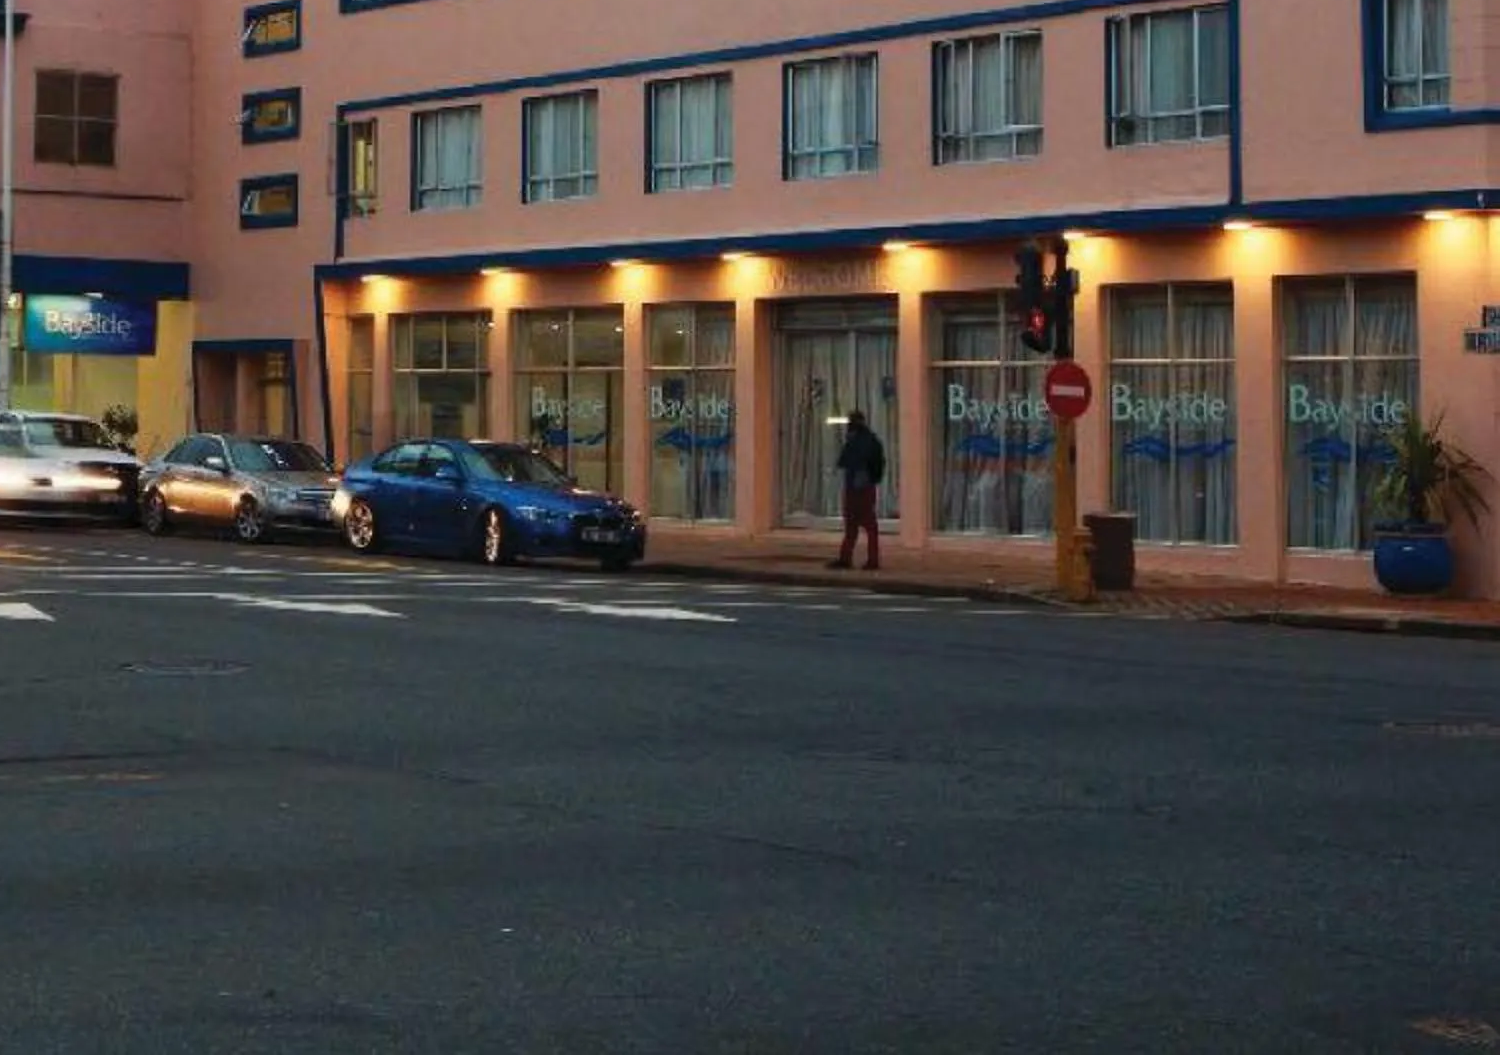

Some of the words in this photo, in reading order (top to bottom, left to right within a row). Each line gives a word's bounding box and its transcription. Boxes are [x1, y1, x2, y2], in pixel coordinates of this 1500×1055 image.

[43, 309, 132, 340] Bayside
[531, 385, 606, 426] Bayde
[948, 383, 1049, 427] Bayside
[1110, 383, 1227, 427] Bayside
[1289, 383, 1407, 430] Bayide
